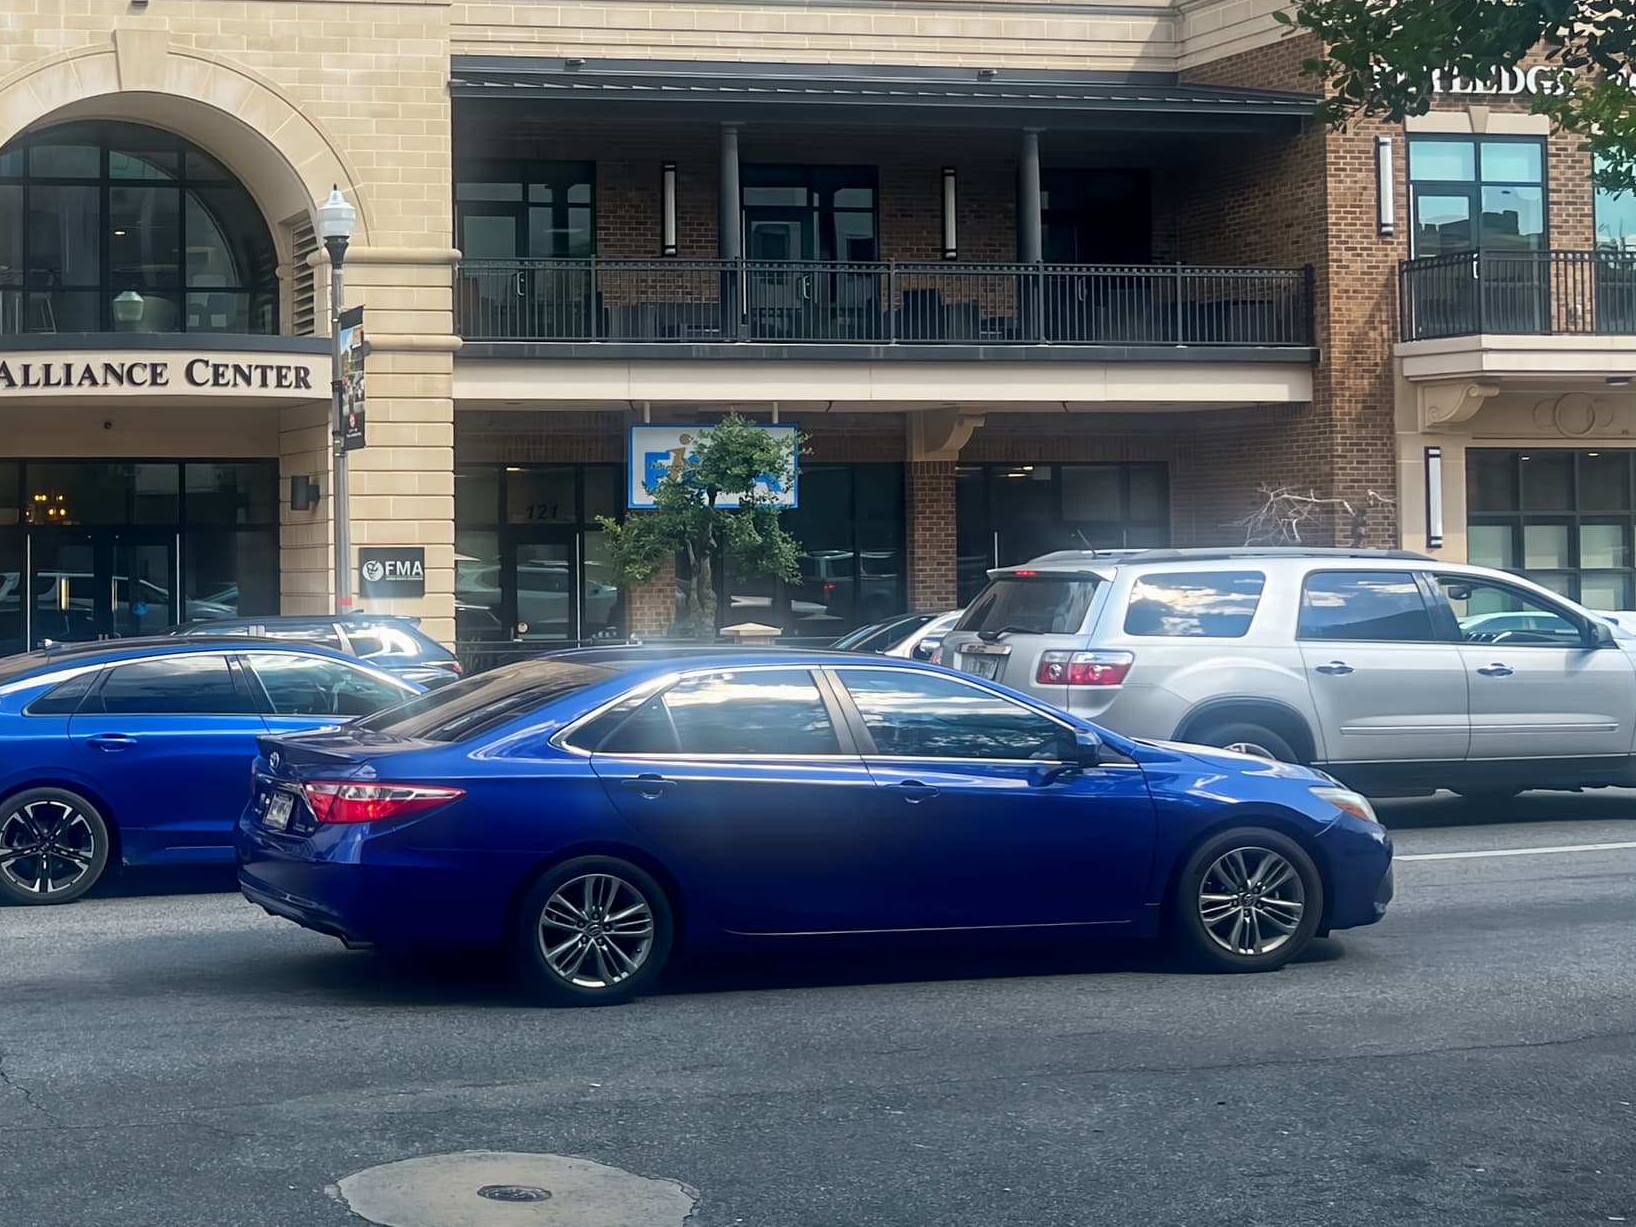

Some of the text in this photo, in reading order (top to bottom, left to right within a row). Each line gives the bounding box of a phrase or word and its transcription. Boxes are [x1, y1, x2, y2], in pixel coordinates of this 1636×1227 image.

[184, 359, 313, 390] CENTER
[526, 503, 558, 519] 121
[385, 560, 424, 575] FMA
